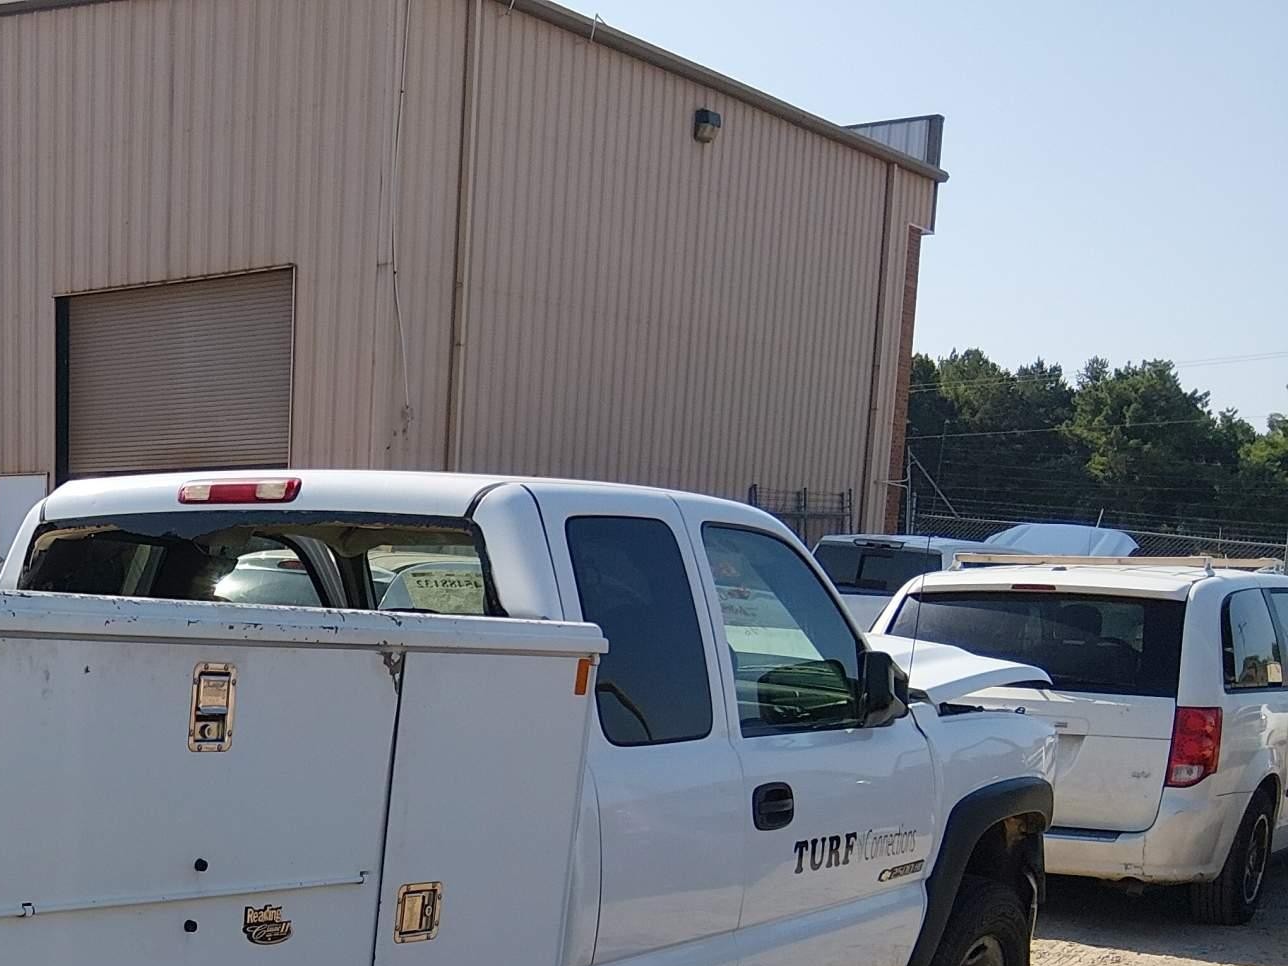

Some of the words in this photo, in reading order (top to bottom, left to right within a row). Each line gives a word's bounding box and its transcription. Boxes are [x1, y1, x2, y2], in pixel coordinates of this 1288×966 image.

[794, 832, 858, 874] TURF
[864, 824, 917, 861] Connections
[247, 907, 282, 923] Reading
